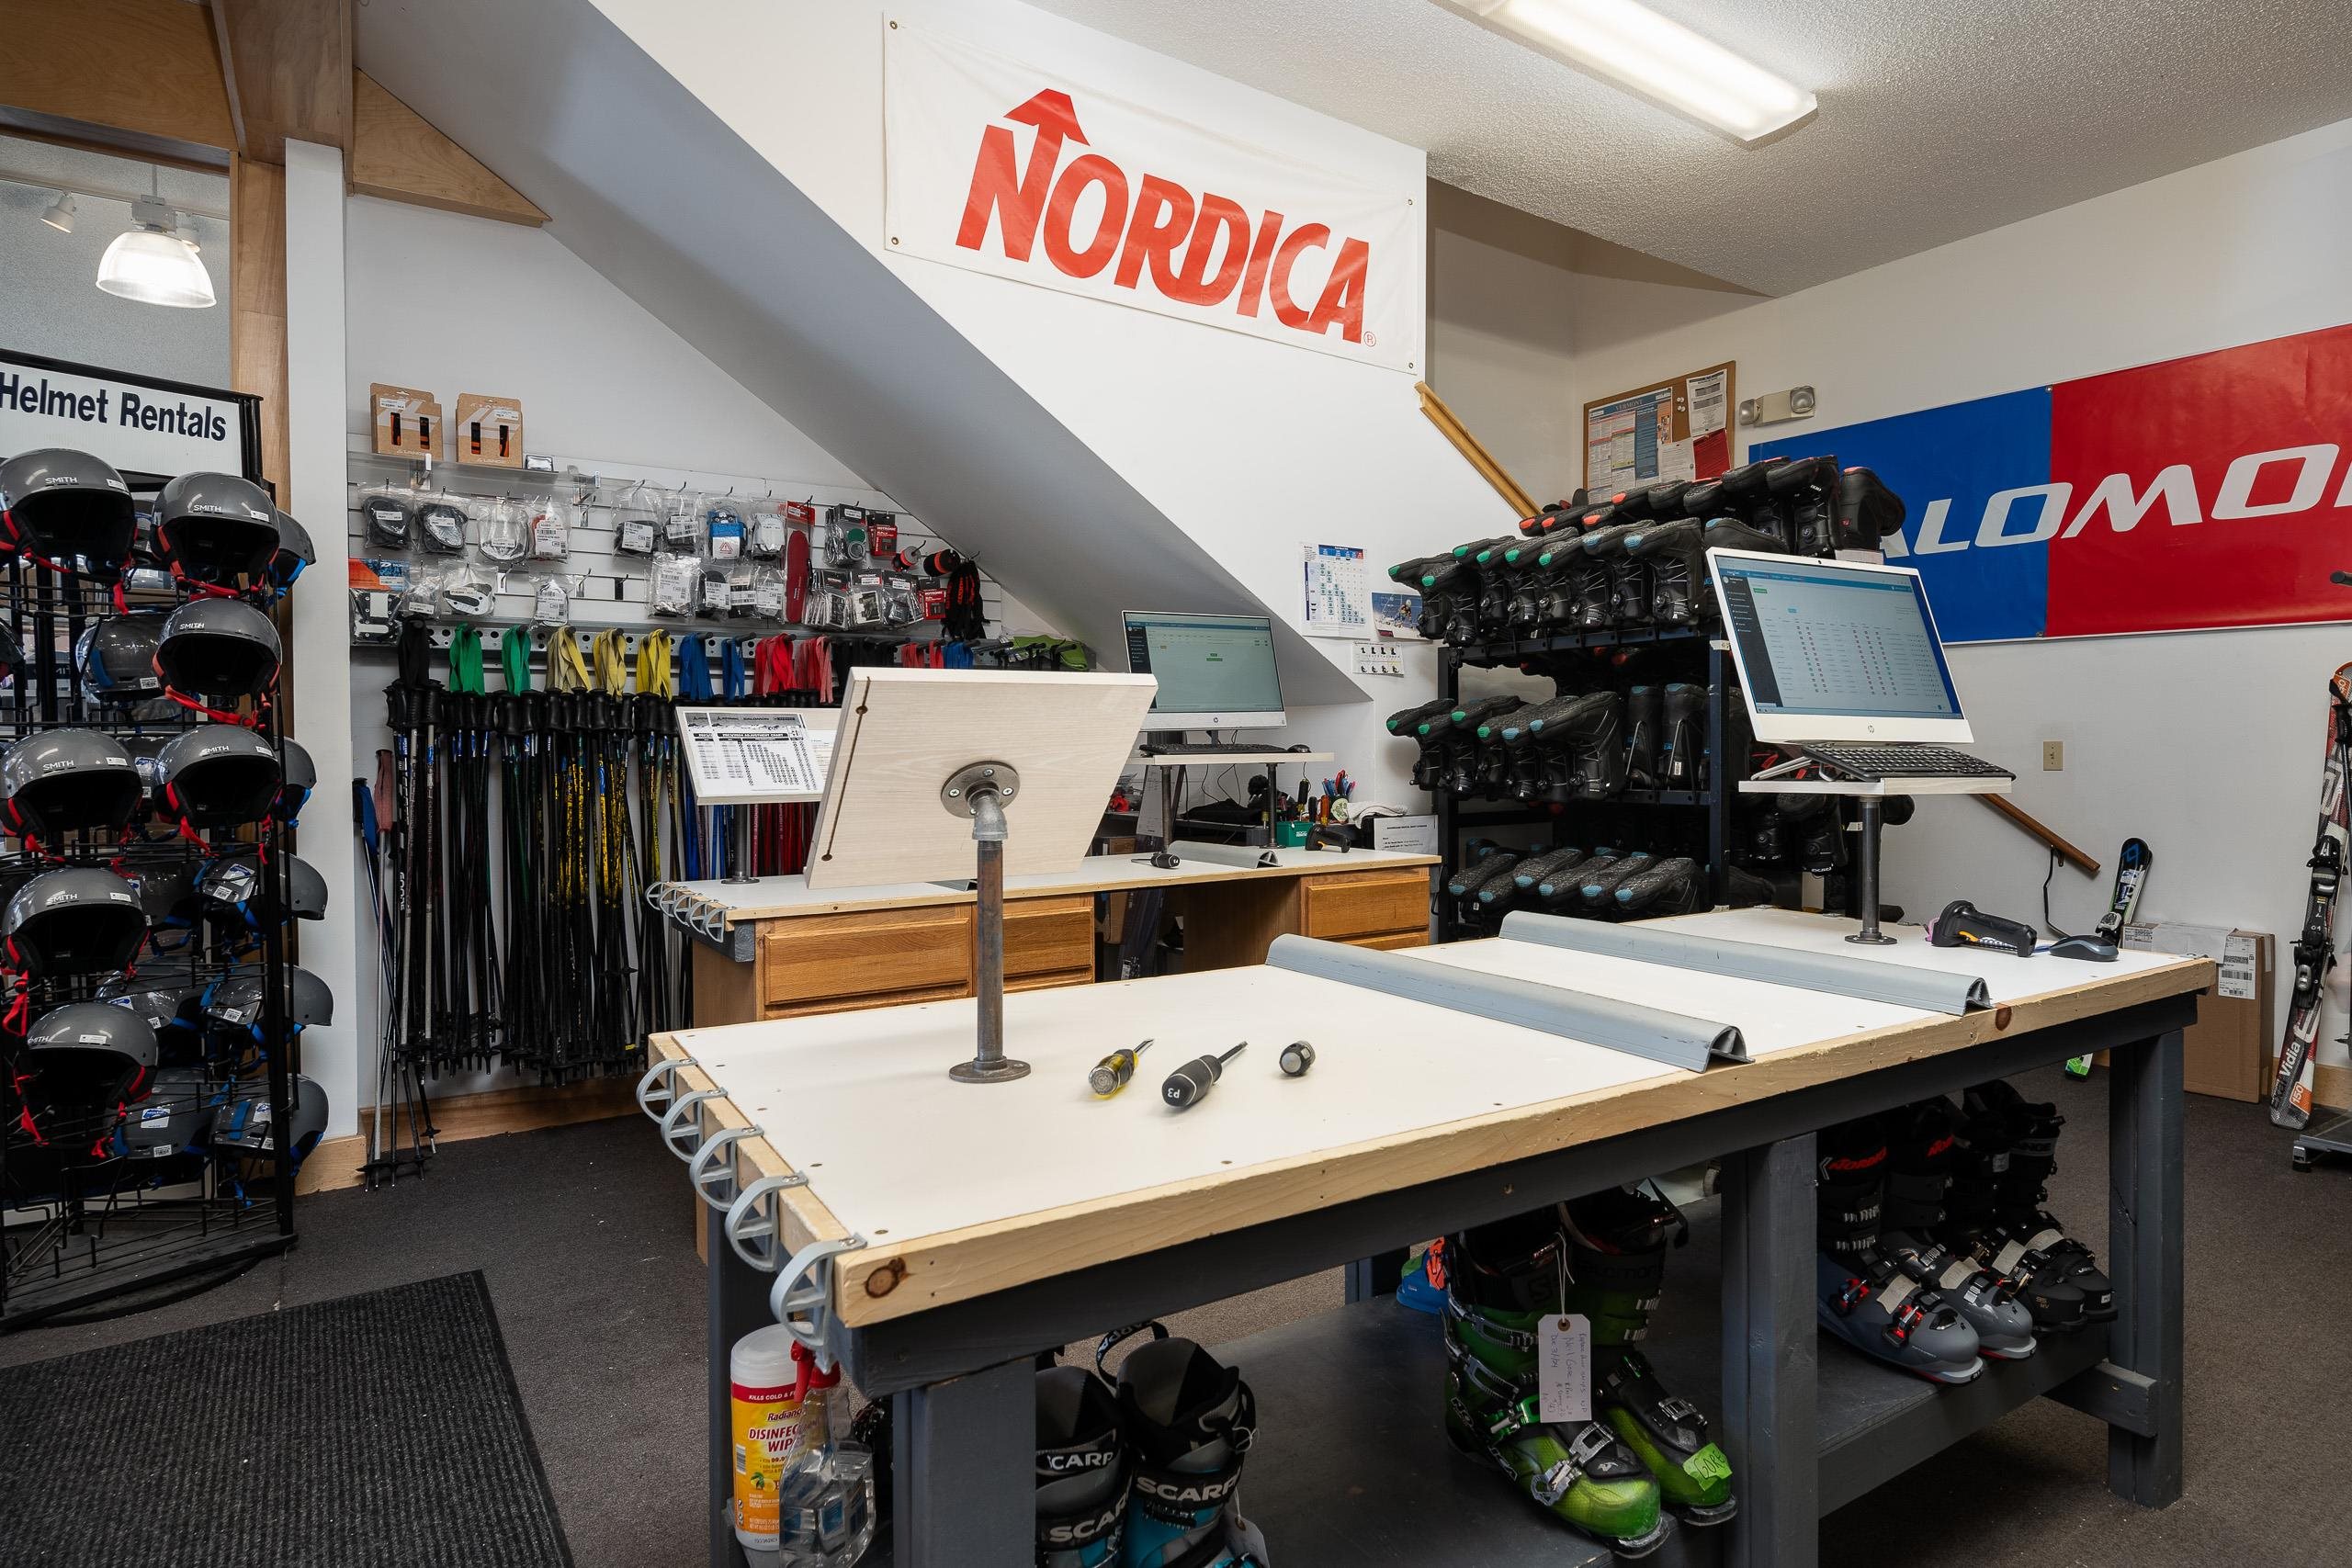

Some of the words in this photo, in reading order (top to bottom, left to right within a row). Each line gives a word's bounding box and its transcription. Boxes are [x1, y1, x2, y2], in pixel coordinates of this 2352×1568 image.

[956, 87, 1370, 344] NORDICA
[0, 372, 108, 423] Helmet
[119, 392, 227, 441] Rentals
[193, 504, 221, 513] SMITH
[1880, 444, 2352, 558] LOMO
[179, 622, 205, 630] SMITH
[202, 745, 230, 754] SMITH
[43, 760, 74, 771] SMITH
[47, 893, 78, 905] SMITH
[2278, 1041, 2301, 1077] Vidia
[2291, 1085, 2304, 1104] 150
[765, 1393, 783, 1401] COLD
[1694, 1450, 1725, 1480] GORE
